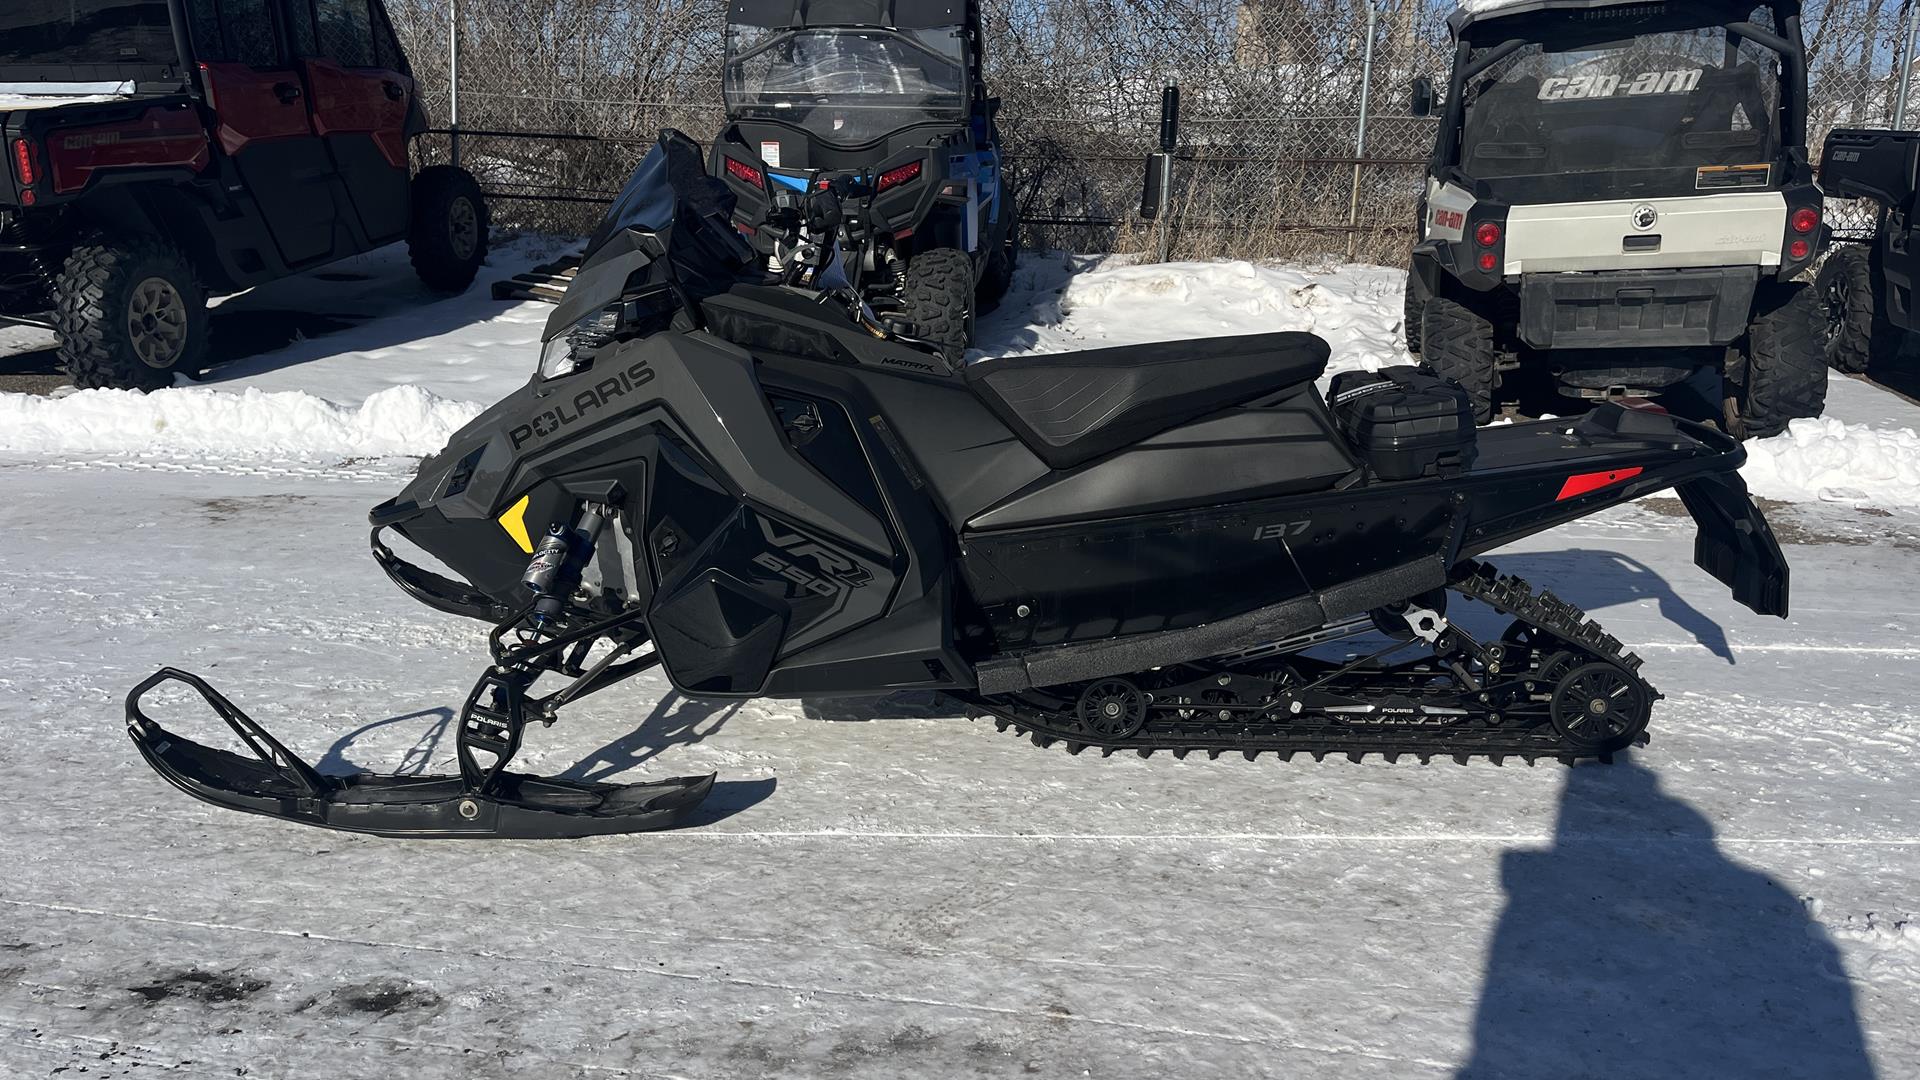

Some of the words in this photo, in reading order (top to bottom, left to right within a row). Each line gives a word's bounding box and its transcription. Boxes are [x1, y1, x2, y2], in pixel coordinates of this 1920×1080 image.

[1537, 68, 1703, 101] can-am
[880, 357, 936, 373] MATRYX
[508, 359, 656, 451] POLARIS
[1253, 519, 1312, 541] 137
[751, 551, 840, 598] 650
[470, 713, 508, 729] POLARIS
